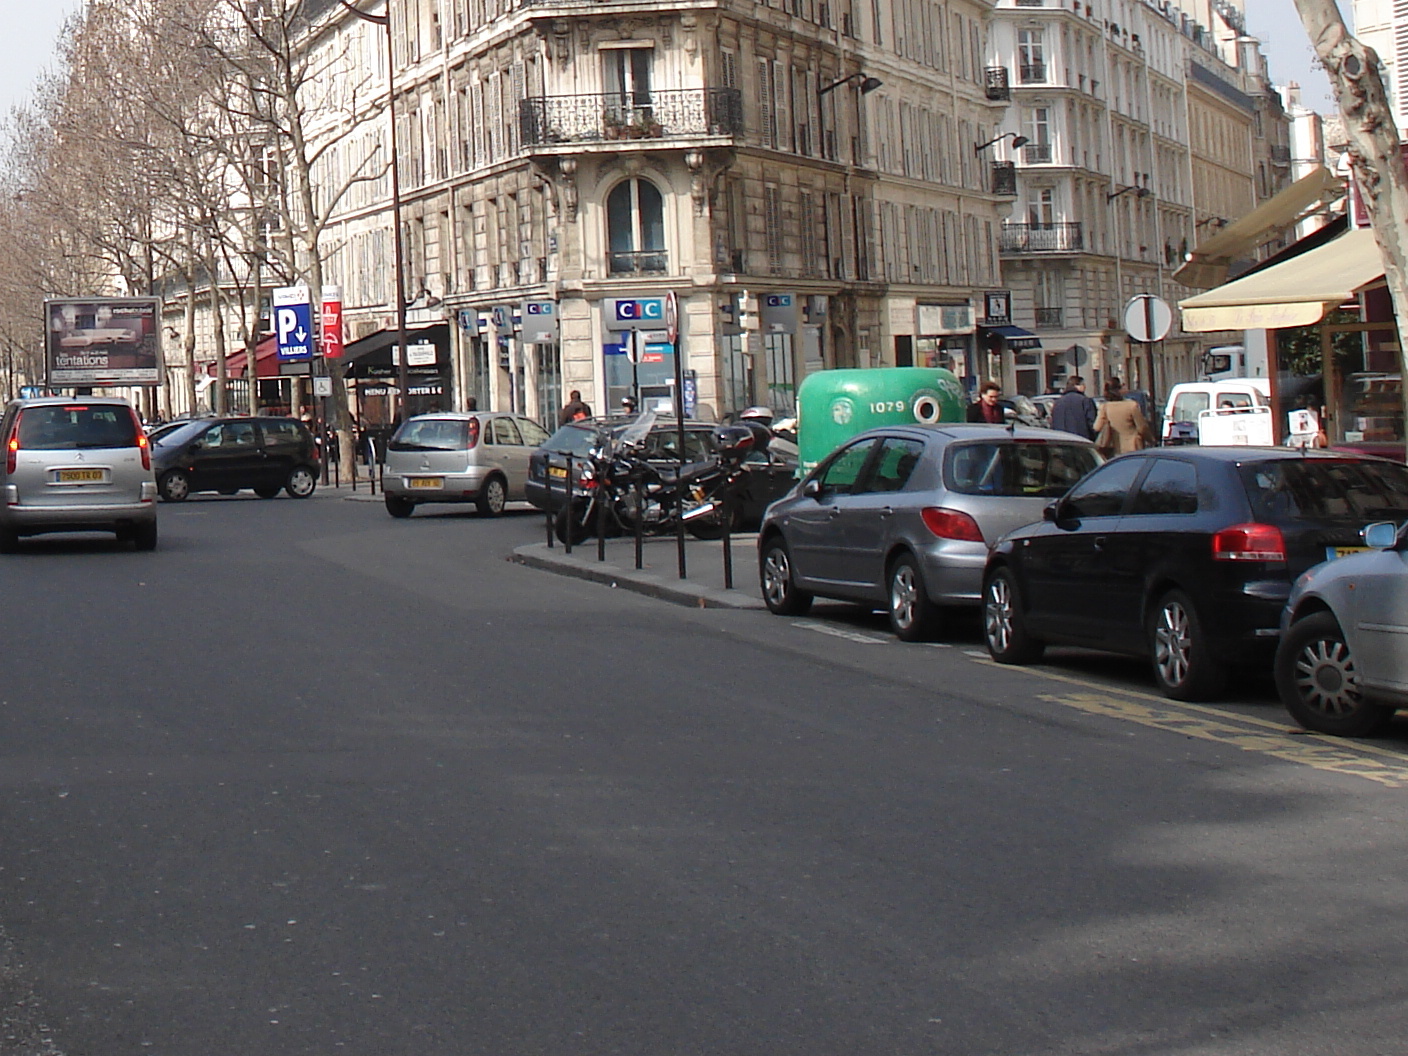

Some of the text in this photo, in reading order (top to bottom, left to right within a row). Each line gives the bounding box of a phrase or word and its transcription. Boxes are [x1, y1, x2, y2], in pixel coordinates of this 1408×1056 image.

[529, 304, 550, 314] CIC
[618, 301, 659, 318] CIC
[278, 309, 297, 344] P
[280, 346, 308, 355] VILLIERS
[56, 355, 109, 366] tentations
[869, 400, 905, 413] 1079
